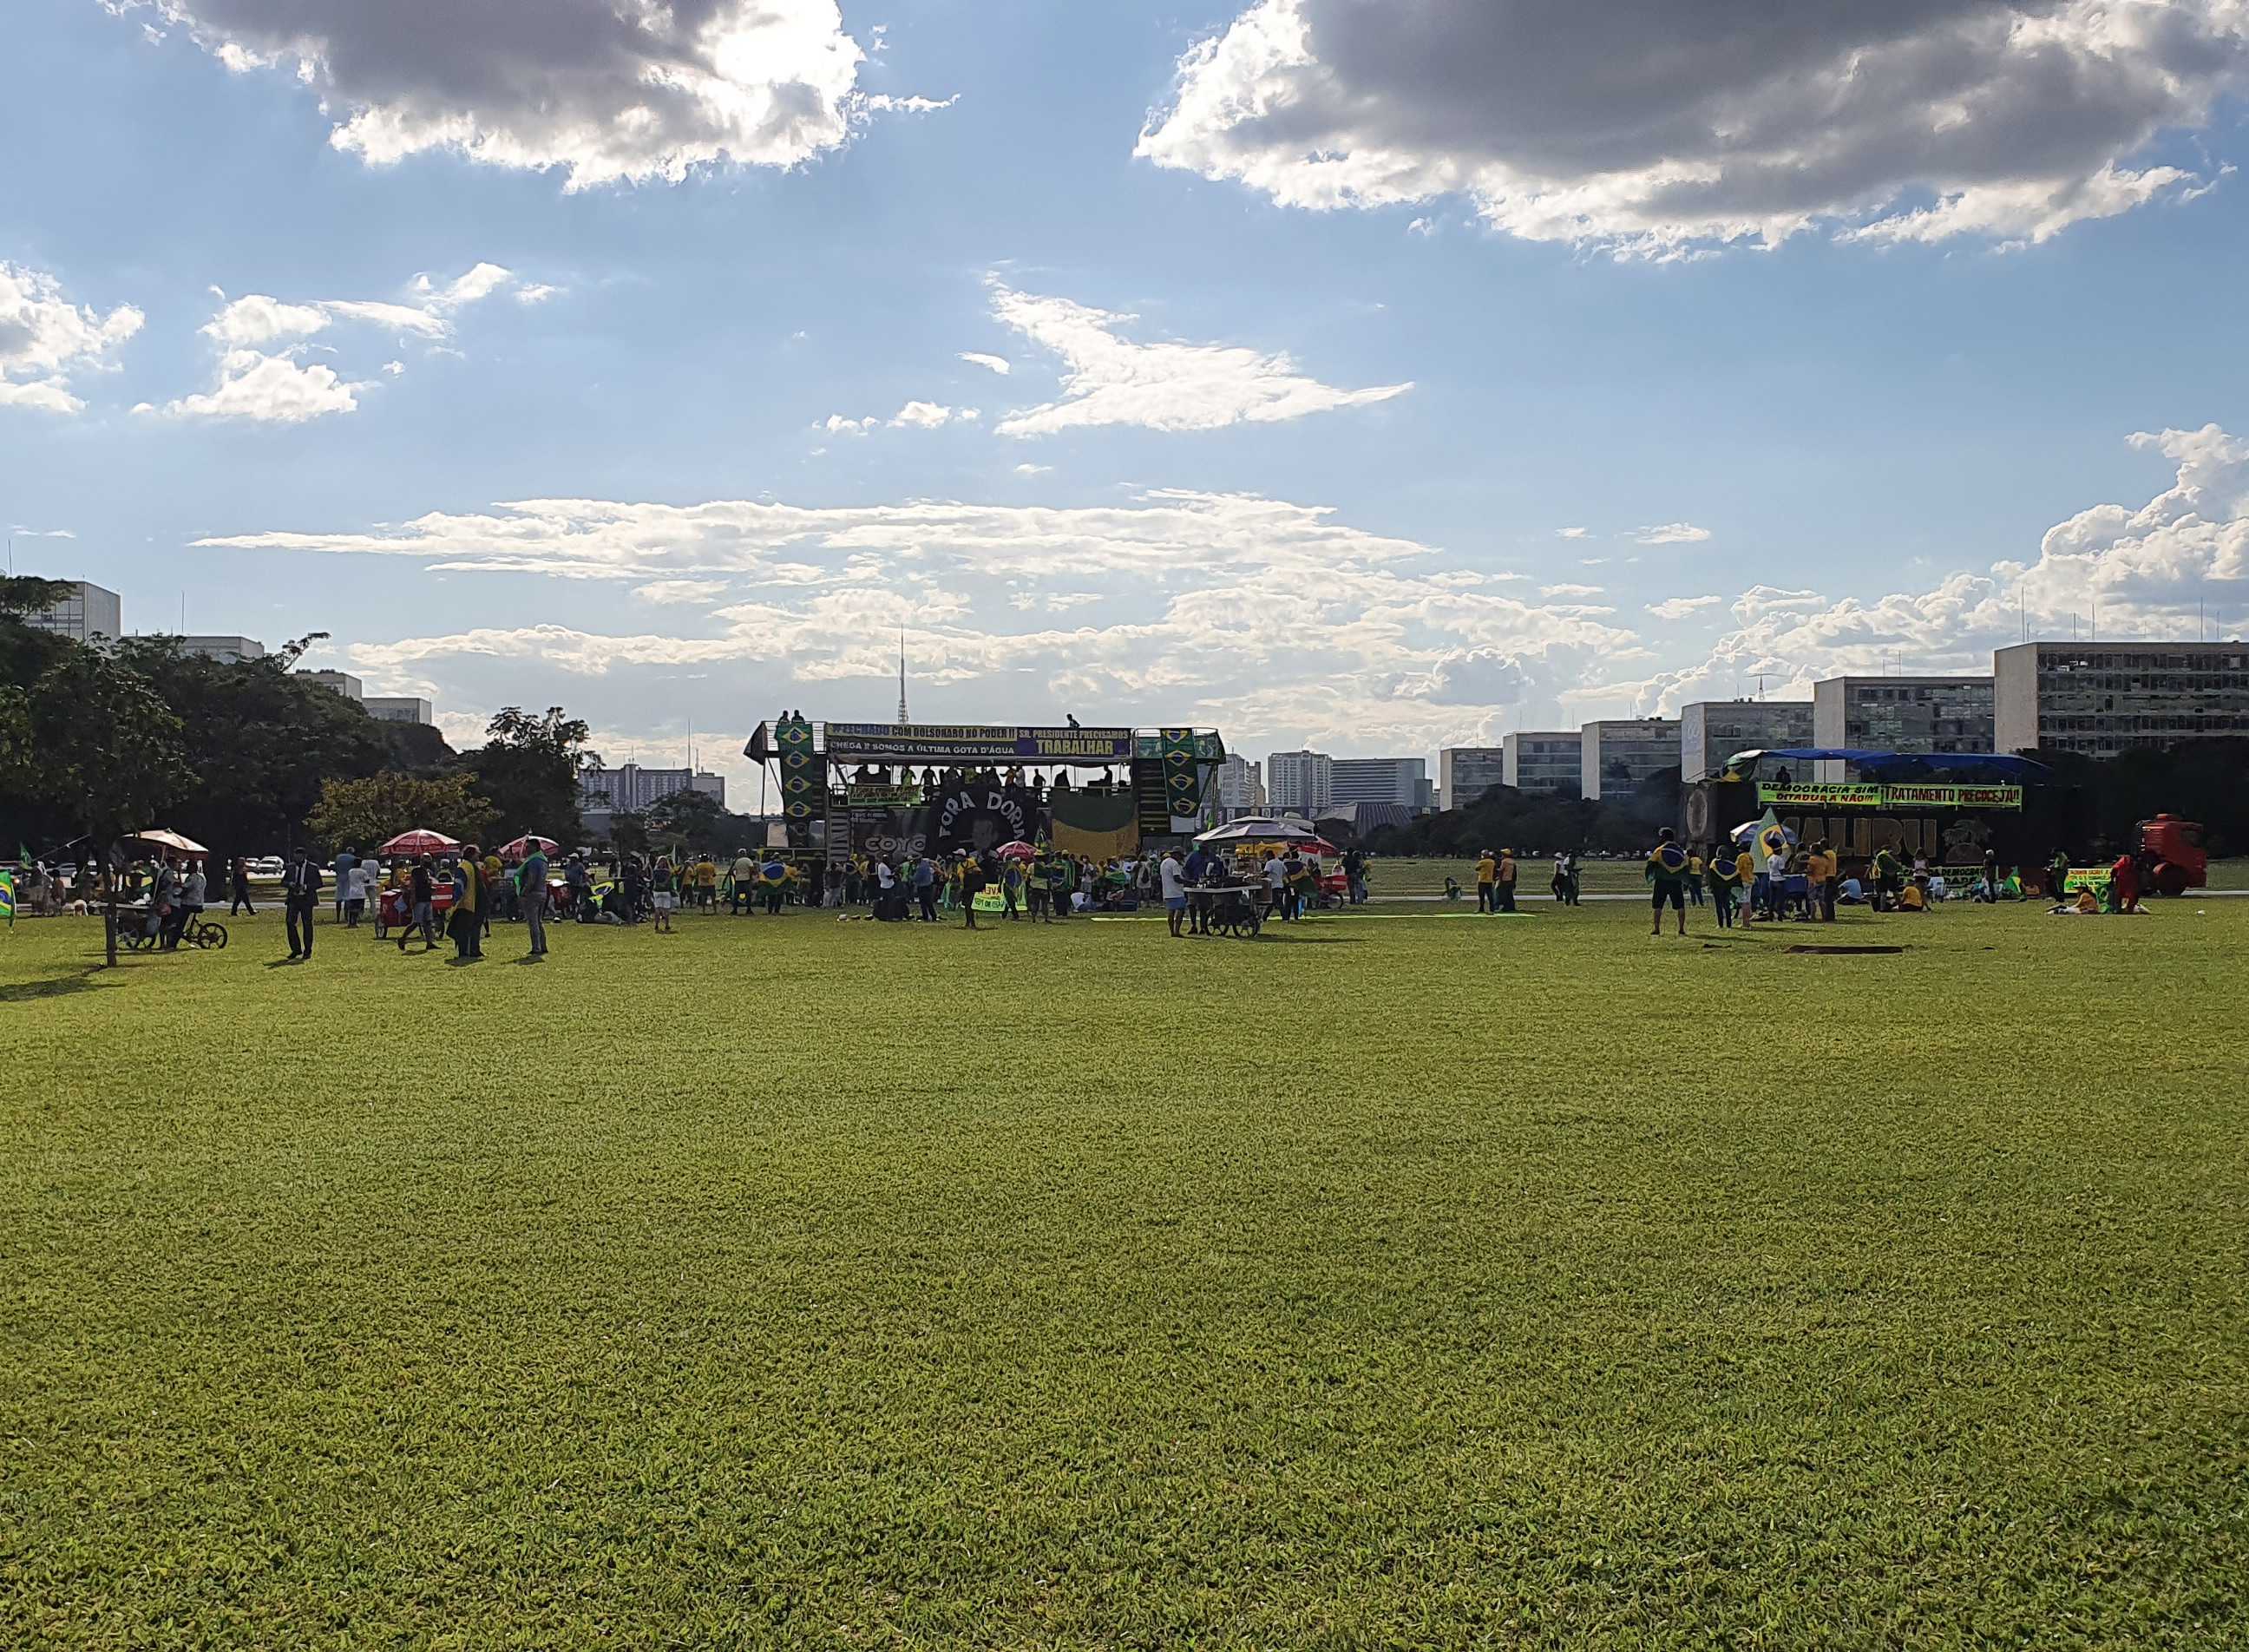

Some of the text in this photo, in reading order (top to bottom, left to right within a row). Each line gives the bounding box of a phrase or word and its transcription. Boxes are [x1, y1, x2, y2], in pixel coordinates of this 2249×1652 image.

[892, 726, 911, 737] COM
[914, 727, 962, 738] BOLSONARO
[966, 728, 977, 738] NO
[979, 728, 1006, 738] PODER
[1033, 730, 1078, 738] PRESIDENTE
[1079, 730, 1128, 739] PRECISAMOS
[830, 741, 862, 751] CHEGA
[872, 743, 905, 751] SOMOS
[916, 744, 950, 753] ÚLTIMA
[1036, 739, 1113, 755] TRABALHAR
[1761, 783, 1850, 793] DEMOCRACIA
[1885, 785, 1955, 802] TRATAMENTO
[1776, 793, 1837, 802] DITADURA
[938, 791, 1025, 840] FORA DORIA
